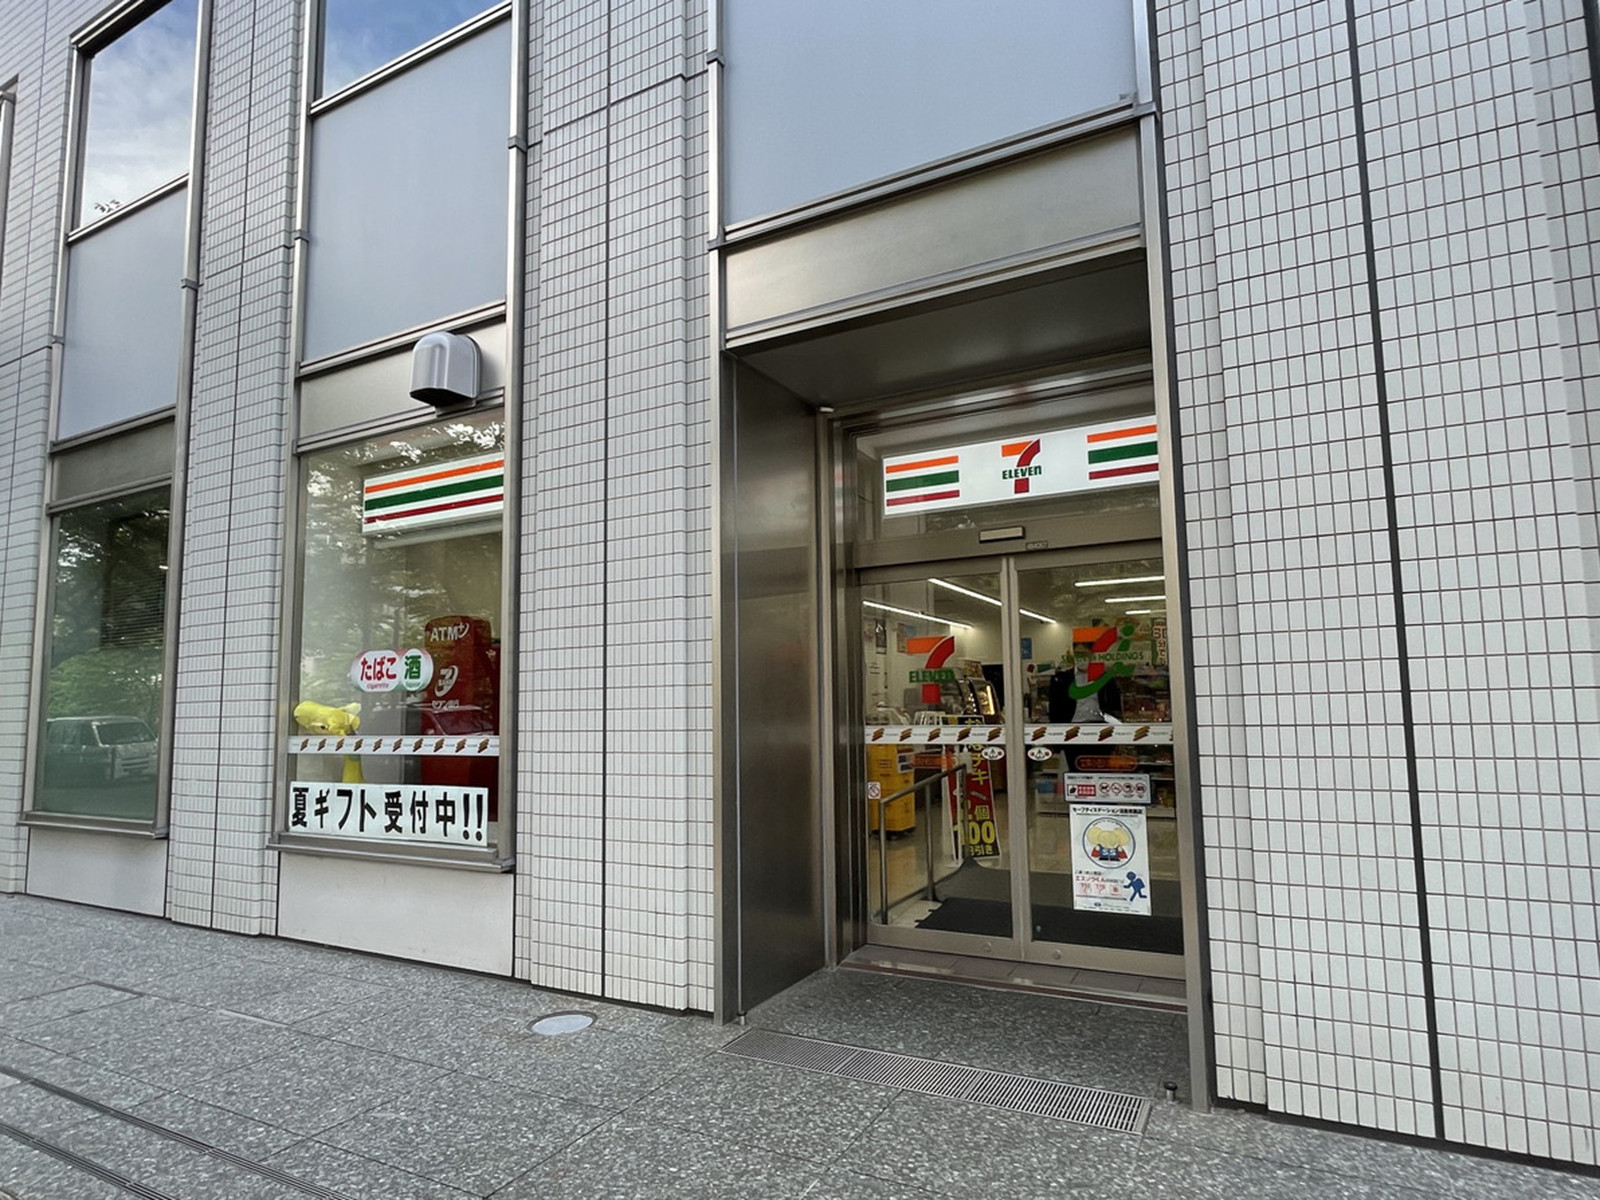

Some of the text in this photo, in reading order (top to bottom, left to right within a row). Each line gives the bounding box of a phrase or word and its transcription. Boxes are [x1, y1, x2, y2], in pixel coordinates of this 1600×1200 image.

[360, 655, 422, 681] たばこ 酒
[291, 786, 484, 842] 夏ギフト受付中!!
